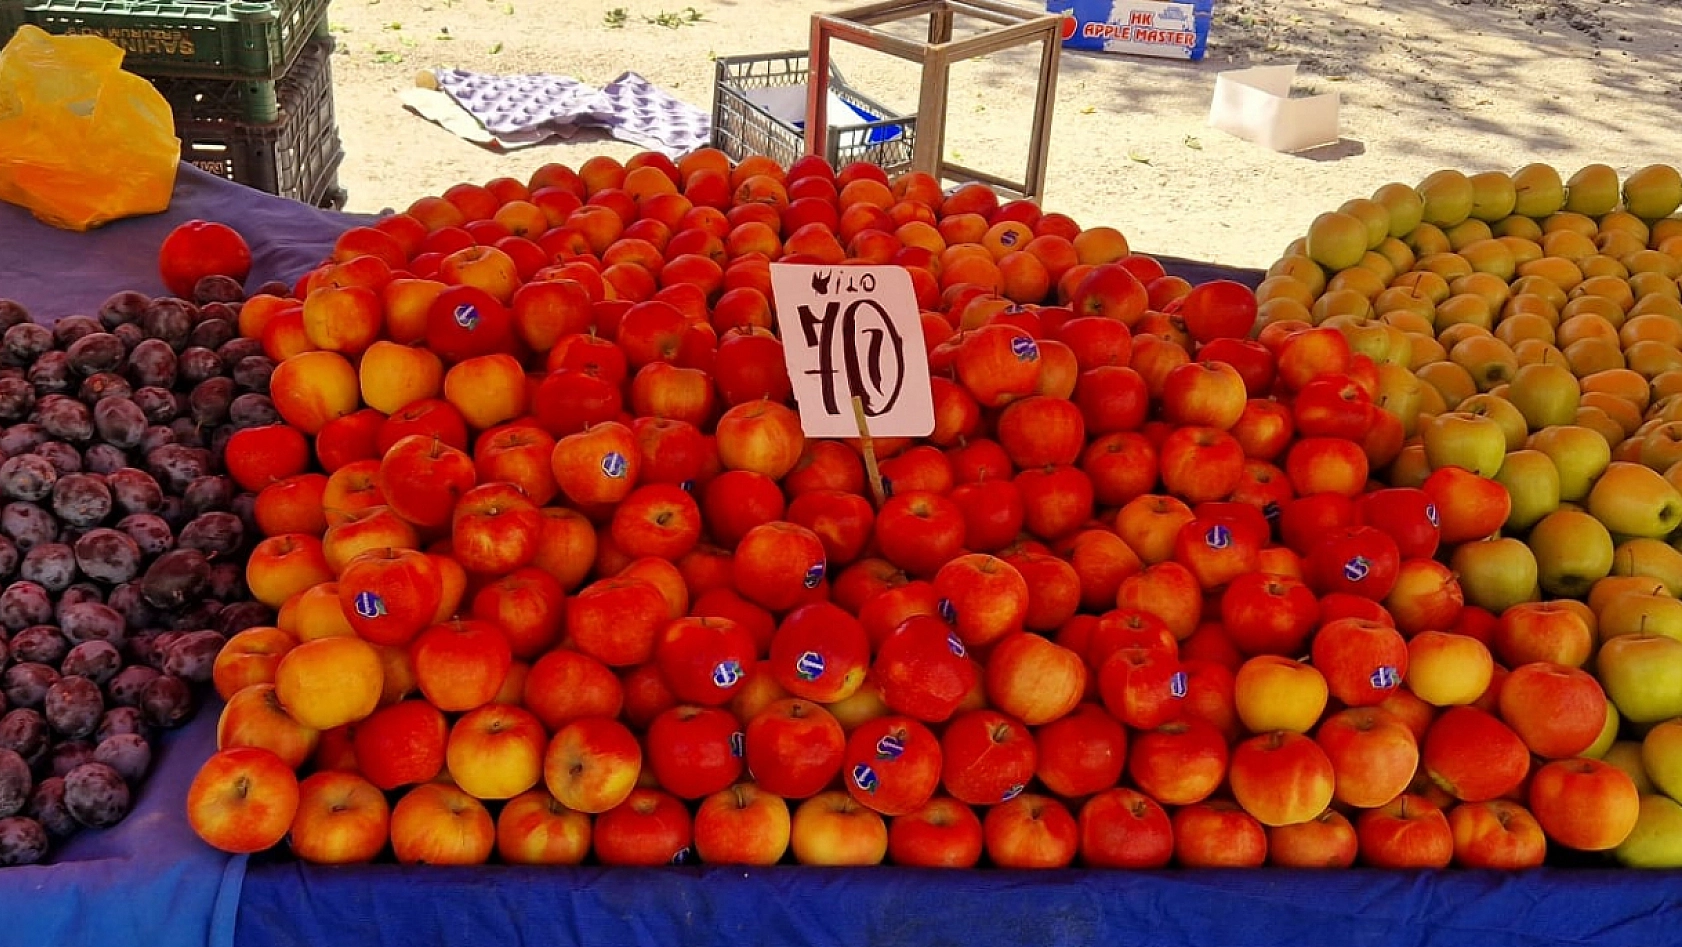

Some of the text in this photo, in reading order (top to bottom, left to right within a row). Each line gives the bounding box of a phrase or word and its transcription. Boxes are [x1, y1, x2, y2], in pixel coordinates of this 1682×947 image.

[1130, 12, 1152, 26] HK
[1084, 23, 1195, 46] APPLE MASTER
